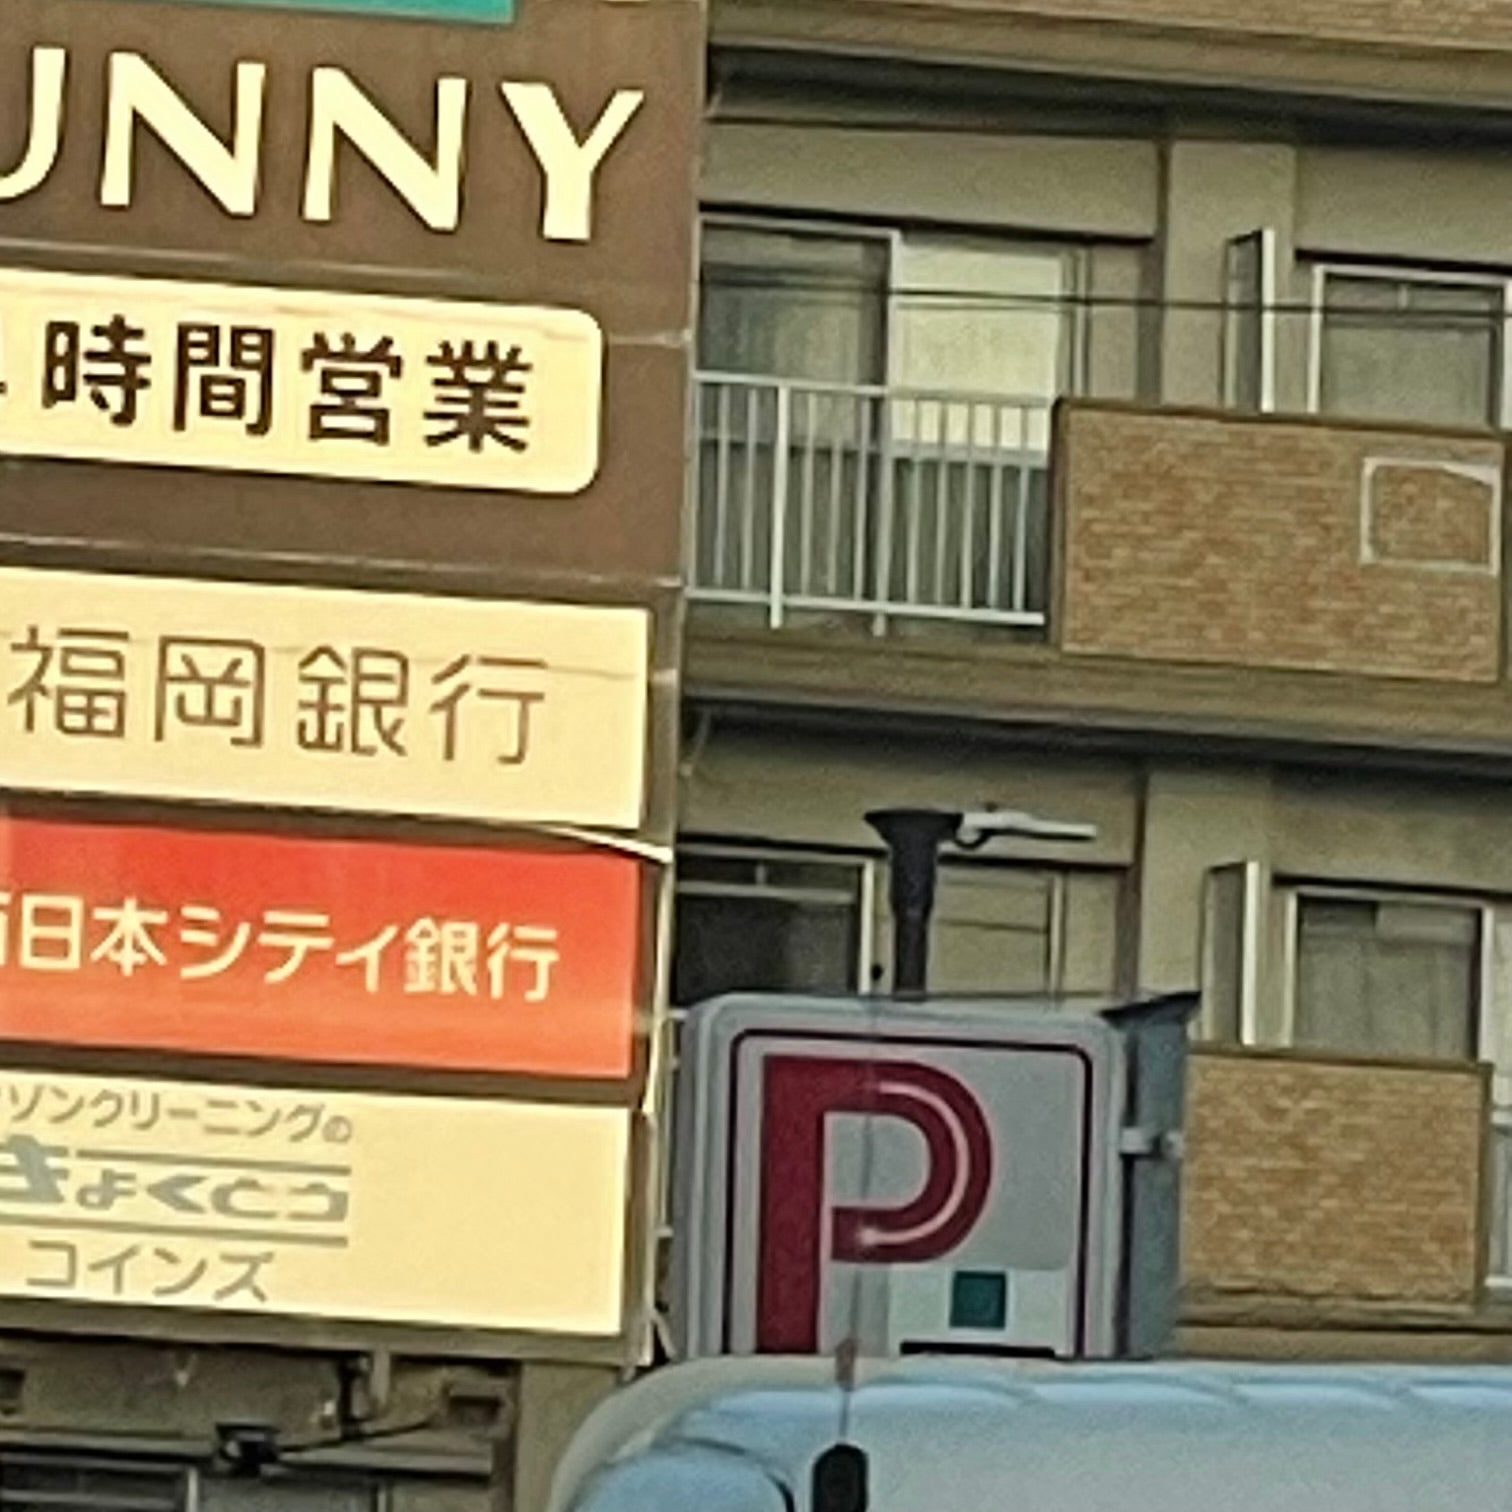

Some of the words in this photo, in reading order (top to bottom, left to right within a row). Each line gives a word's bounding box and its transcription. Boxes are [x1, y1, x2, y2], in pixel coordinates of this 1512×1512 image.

[5, 624, 549, 766] 福岡銀行
[26, 1239, 275, 1302] コインズ
[757, 1056, 993, 1355] P
